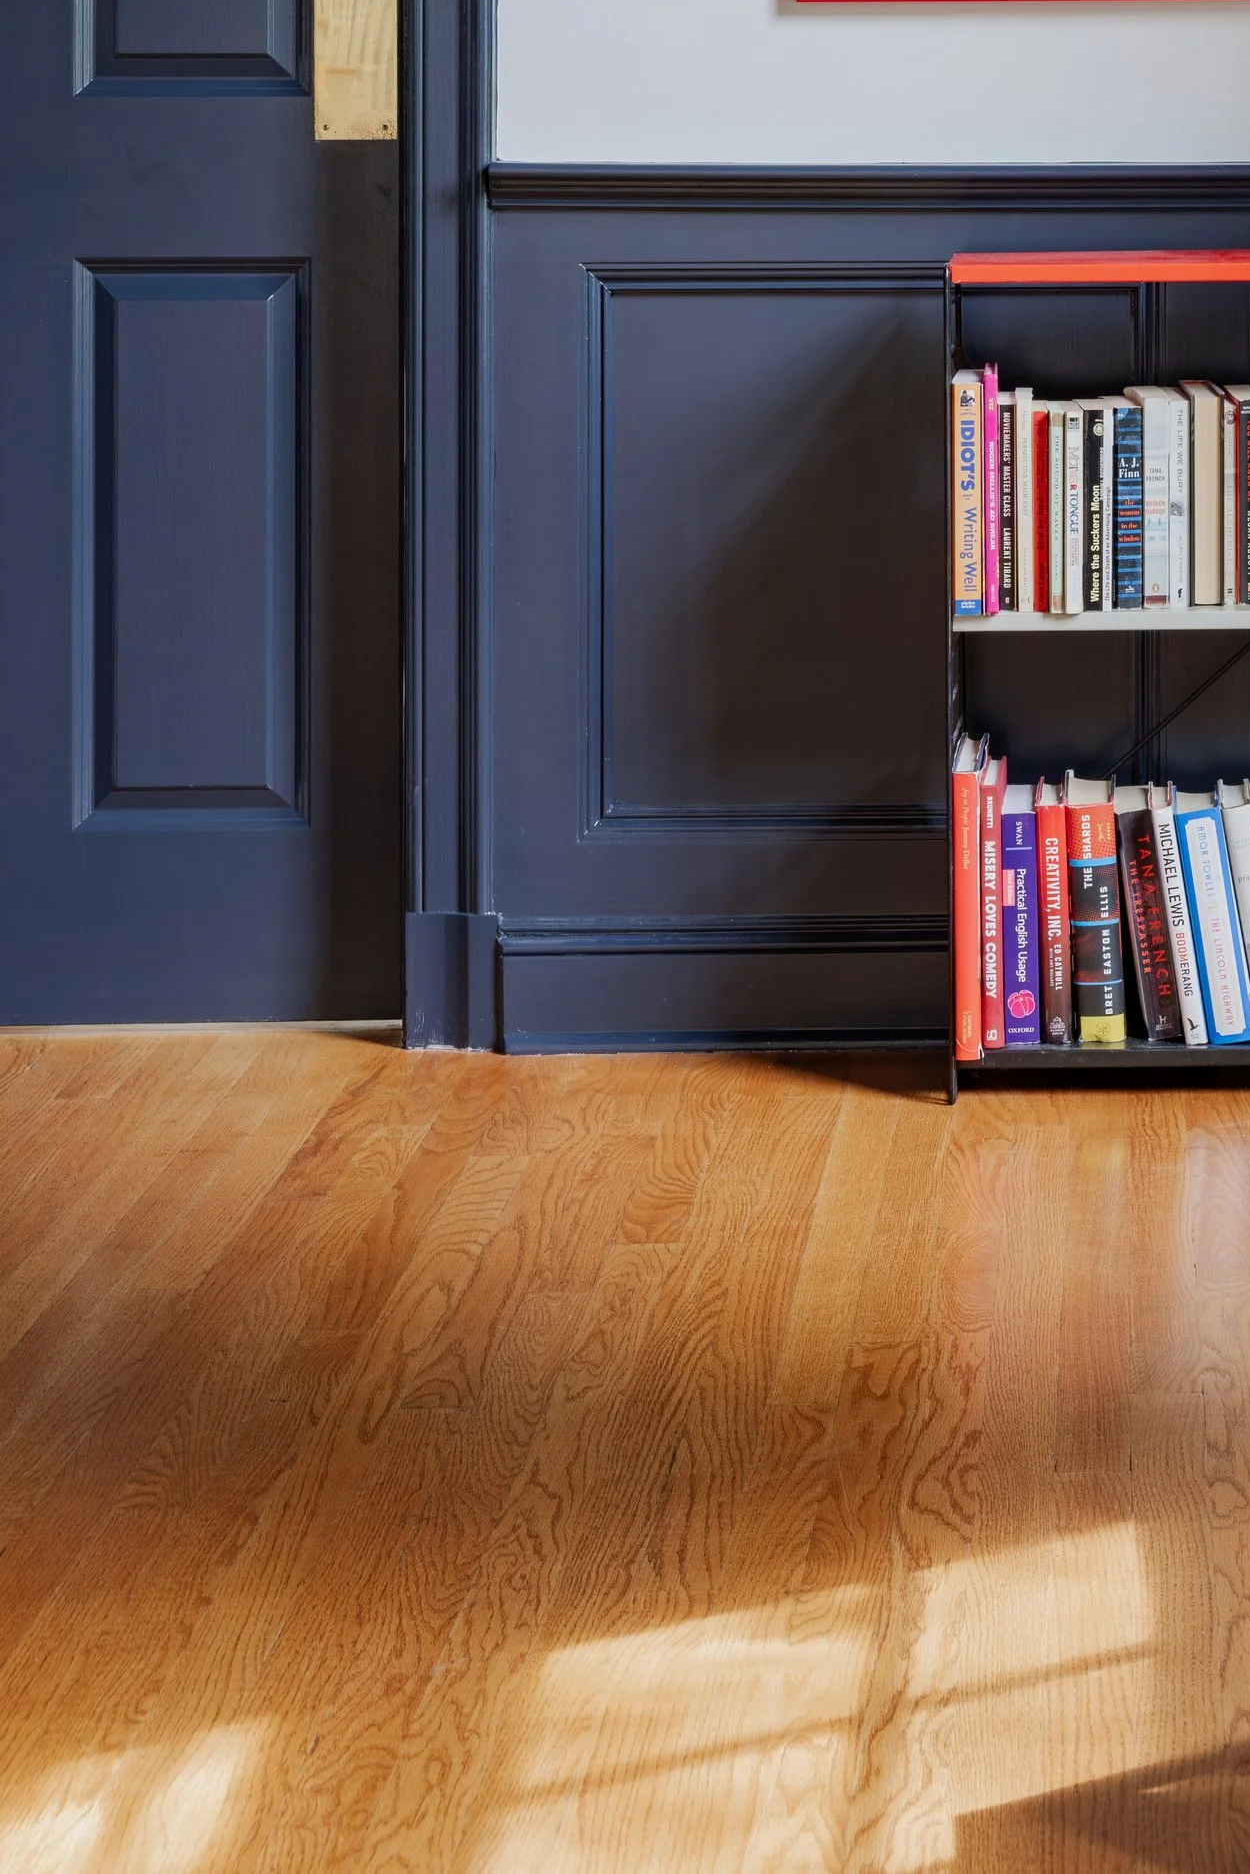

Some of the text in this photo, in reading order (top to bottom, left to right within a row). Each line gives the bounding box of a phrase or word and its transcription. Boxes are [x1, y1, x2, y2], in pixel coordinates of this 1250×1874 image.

[960, 420, 976, 492] IDIOT'S
[1069, 447, 1079, 491] MOTHER
[1119, 469, 1140, 478] Finn
[1120, 458, 1139, 467] A. J.
[1177, 452, 1183, 466] WE
[1003, 466, 1011, 493] MASTER
[960, 507, 978, 558] Writing
[990, 510, 995, 520] AD
[1070, 492, 1078, 534] TONGUE
[1090, 486, 1099, 602] Where the Suckers Moon
[964, 562, 978, 592] Well
[1081, 815, 1091, 859] SHARDS
[985, 841, 996, 890] MISERY
[1084, 867, 1093, 889] THE
[1045, 838, 1061, 940] CREATIVITY, INC.
[1100, 886, 1109, 918] ELLIS
[1158, 824, 1193, 997] MICHAEL LEWIS BOOMERANG
[985, 896, 996, 937] LOVES
[1015, 869, 1028, 982] Practical English Usage
[1129, 860, 1151, 974] THE TRESPASSER
[1138, 835, 1172, 996] TANA FRENCH
[1198, 826, 1234, 1026] AMOR TOWLES THE LINCOLN HIGHWAY
[986, 942, 996, 998] COMEDY
[1054, 945, 1062, 990] ED CATMULL
[1102, 929, 1111, 974] EASTON
[1105, 986, 1113, 1014] BRET
